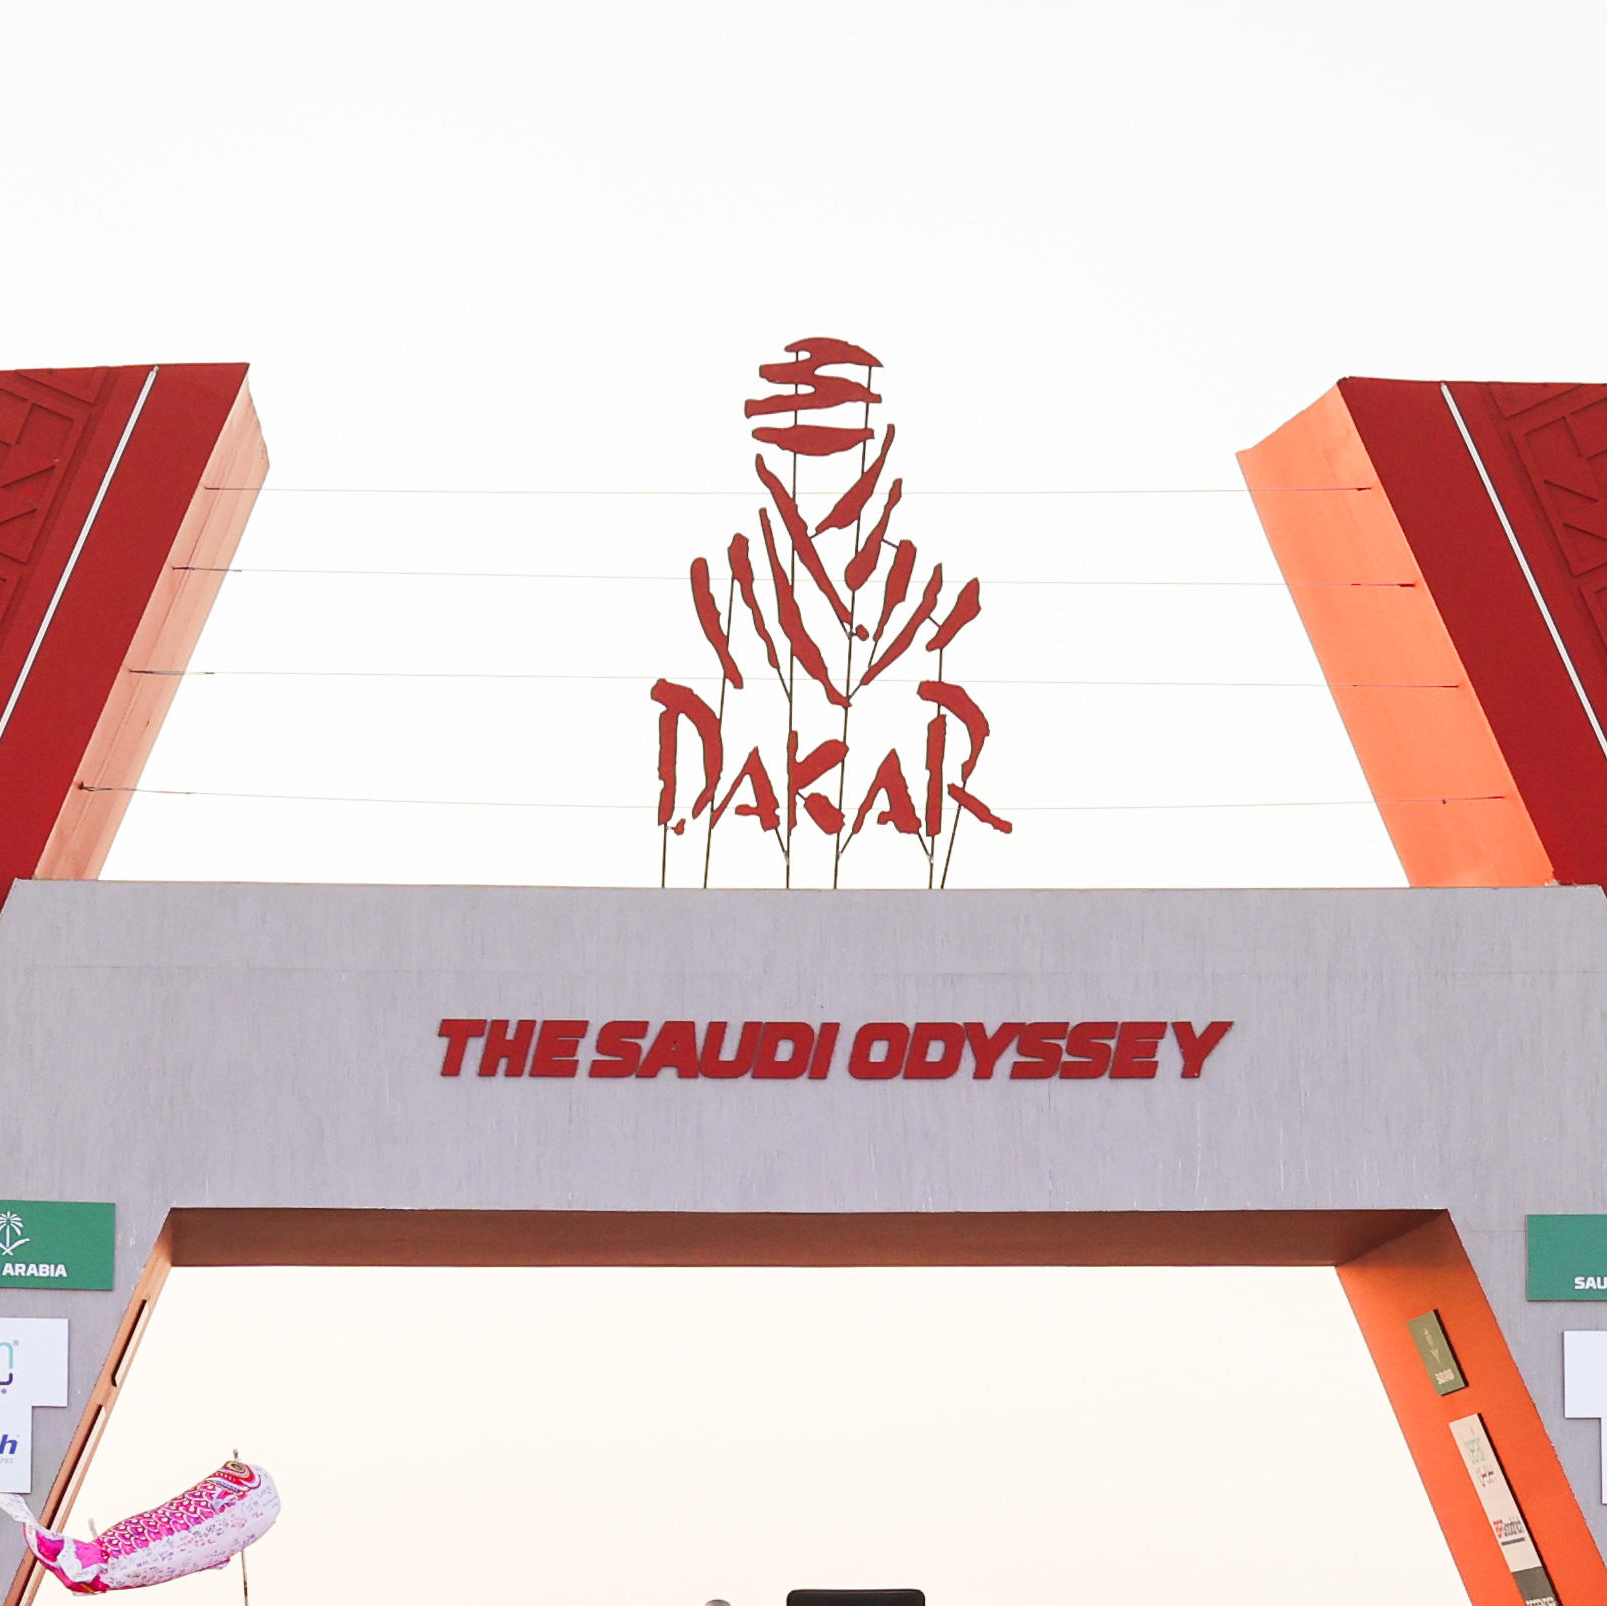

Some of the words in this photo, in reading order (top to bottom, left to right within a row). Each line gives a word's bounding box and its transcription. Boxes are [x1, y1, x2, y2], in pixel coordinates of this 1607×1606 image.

[649, 678, 1013, 837] DAKAR
[437, 1018, 589, 1078] THE
[589, 1019, 841, 1080] SAUDI
[847, 1019, 1234, 1081] ODYSSEY
[1, 1262, 68, 1278] ARABIA
